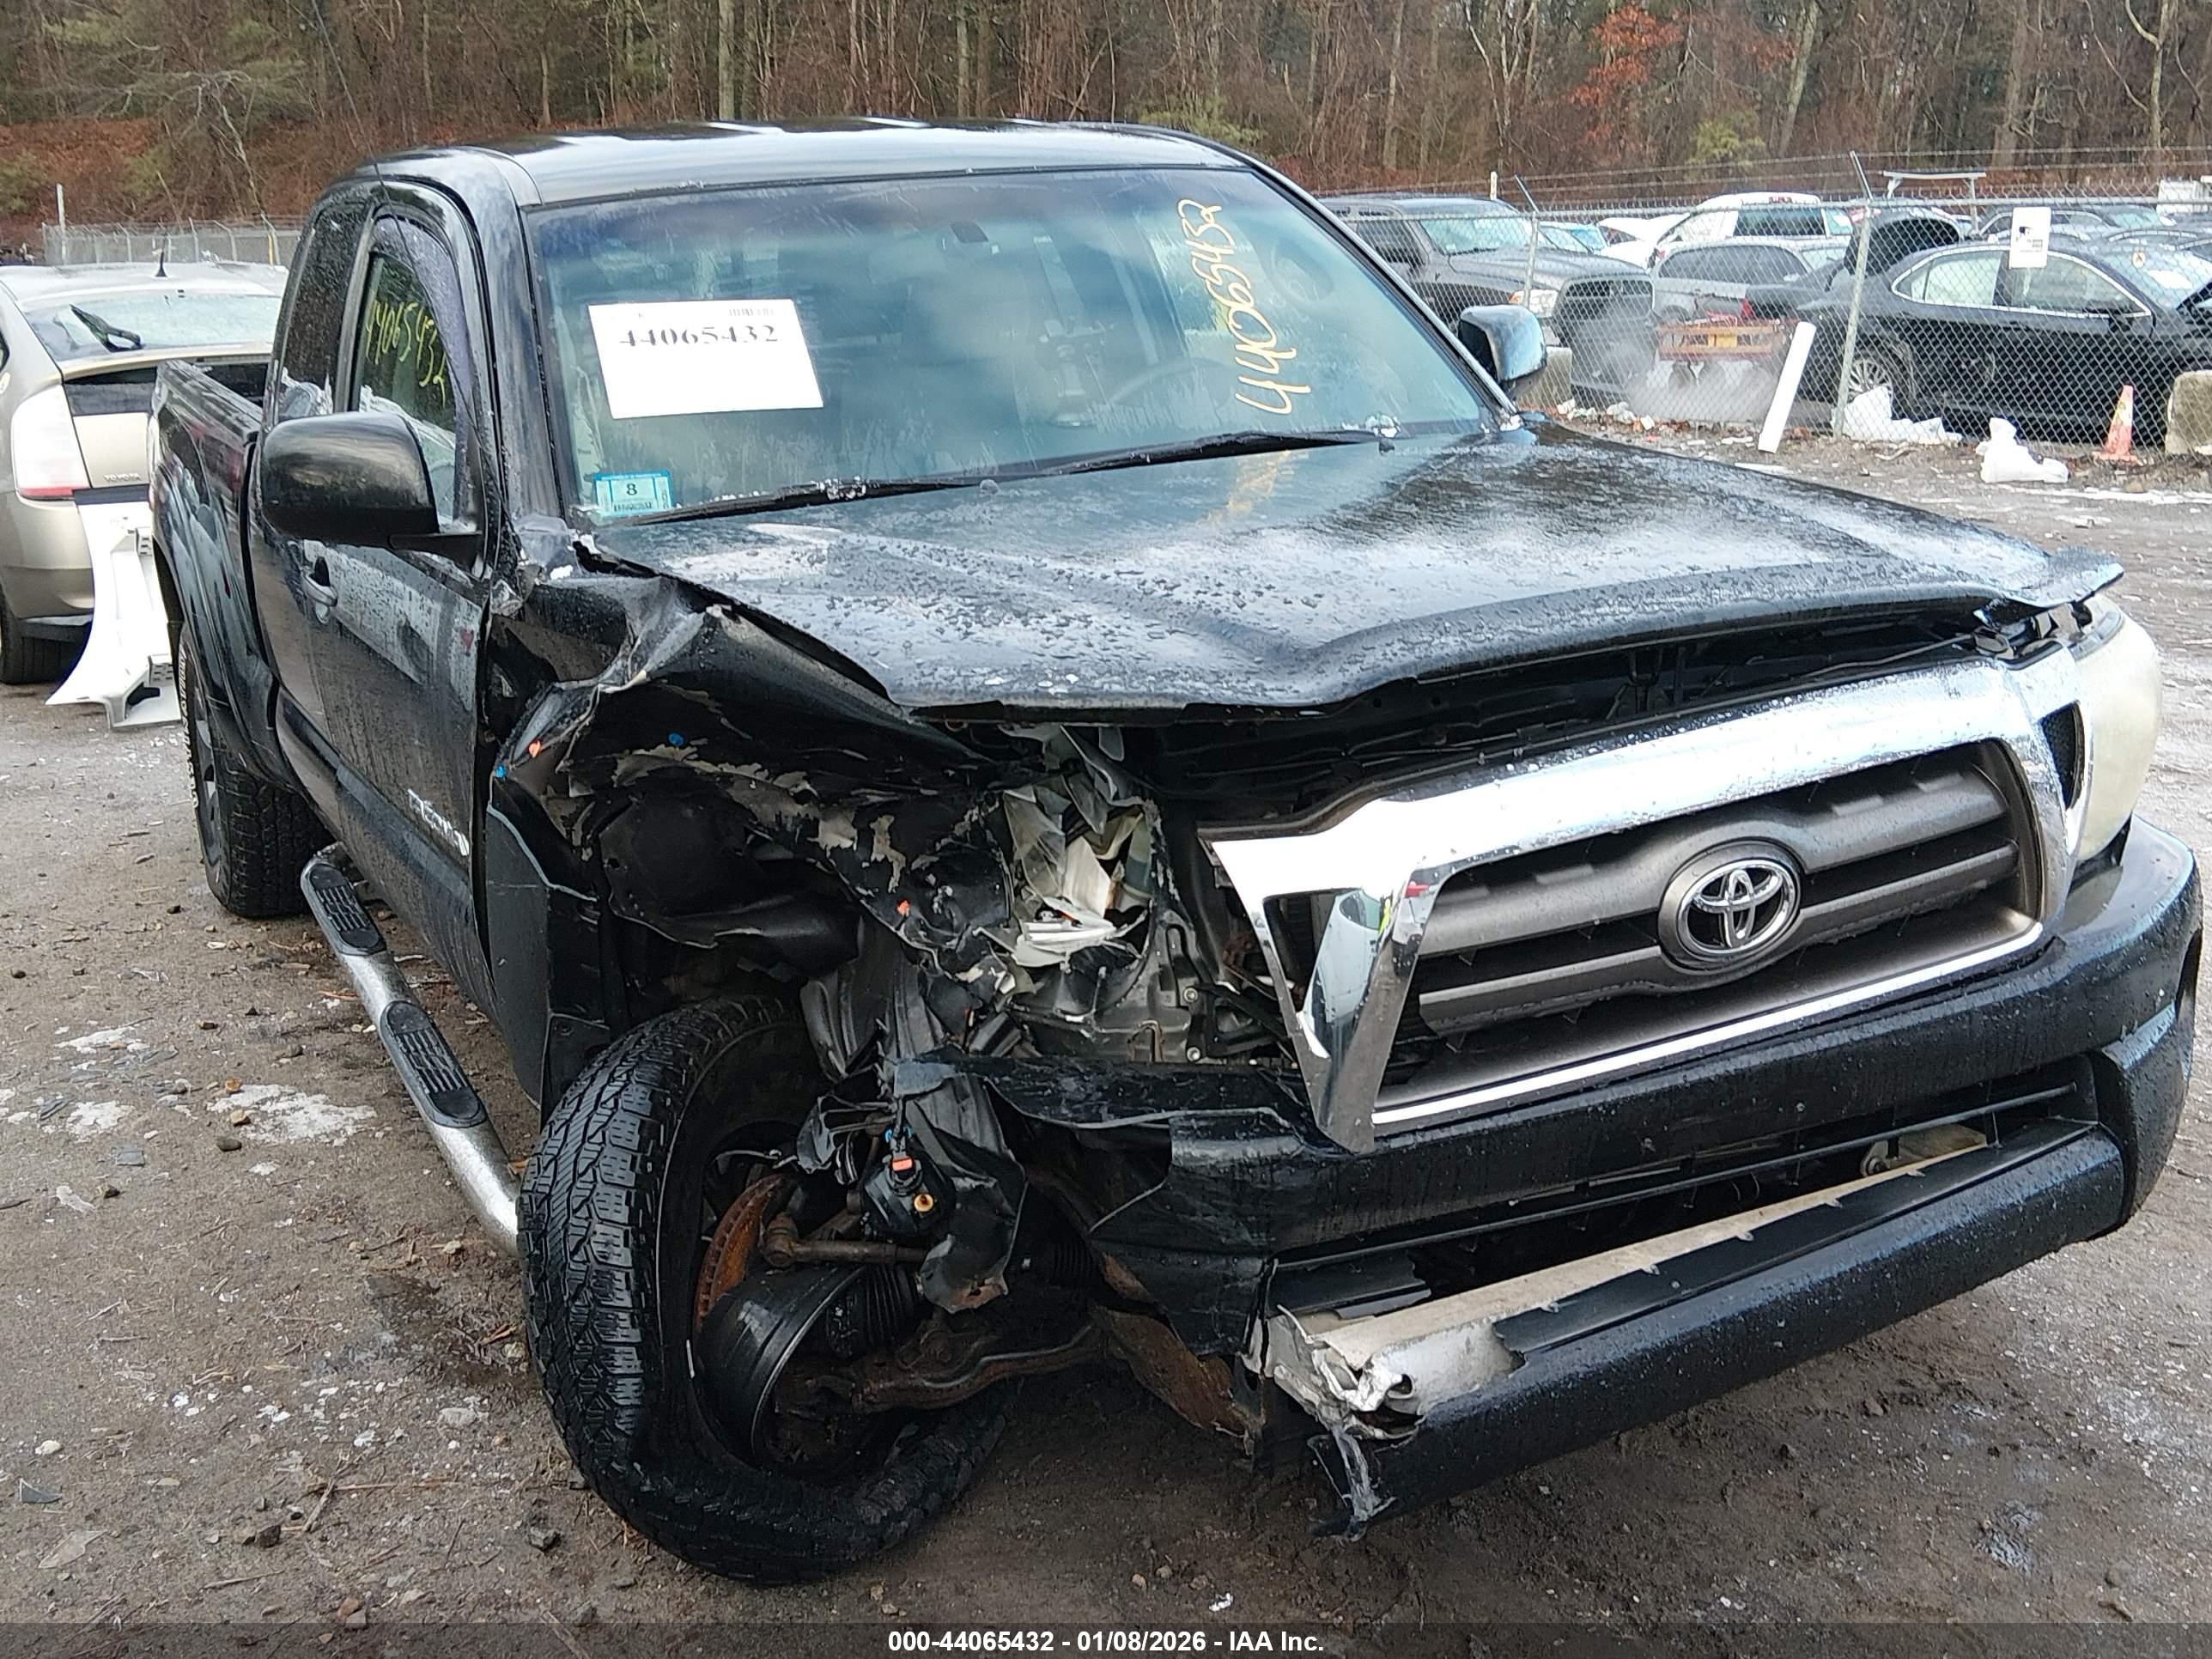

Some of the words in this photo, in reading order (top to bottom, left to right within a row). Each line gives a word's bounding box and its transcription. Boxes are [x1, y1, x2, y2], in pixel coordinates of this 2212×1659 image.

[1177, 198, 1312, 415] 44065432
[619, 325, 779, 347] 44065432
[626, 483, 638, 495] 8
